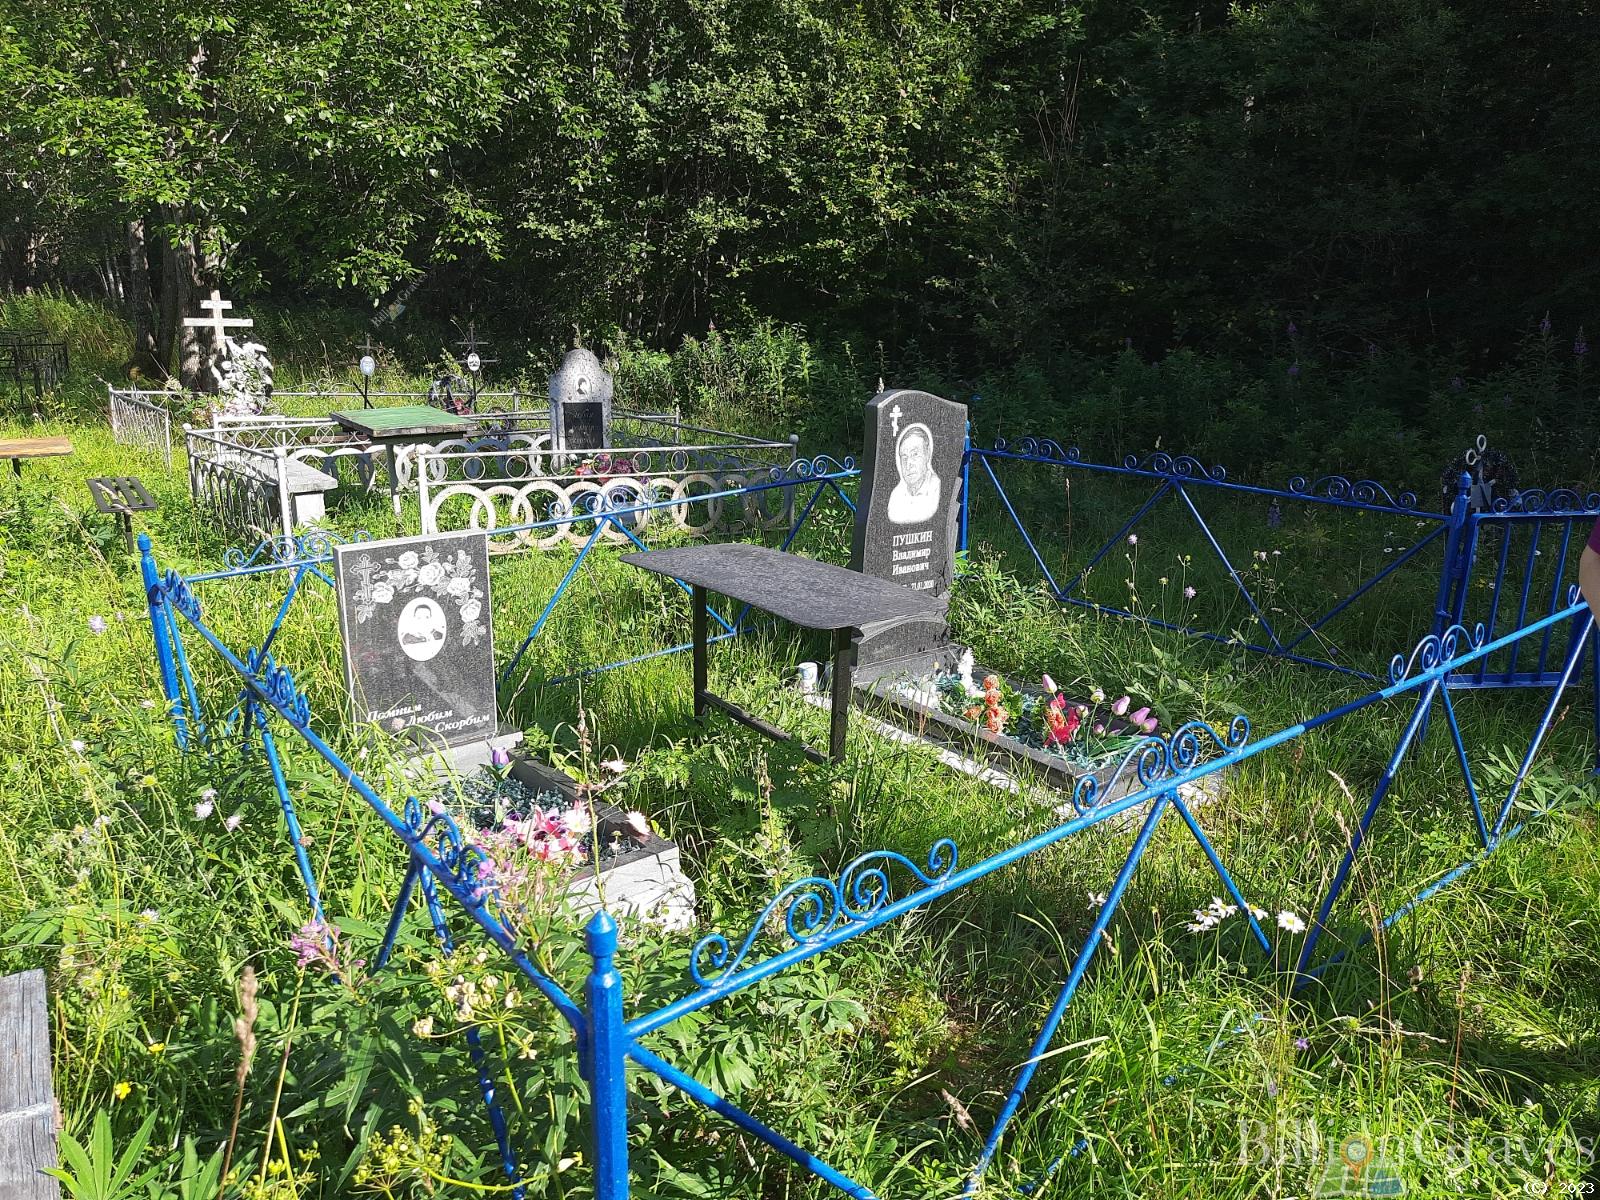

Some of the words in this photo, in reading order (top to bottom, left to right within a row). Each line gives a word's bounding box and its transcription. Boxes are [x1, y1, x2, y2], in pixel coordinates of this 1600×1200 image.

[893, 531, 933, 546] ПУШКИН
[892, 548, 931, 561] Владимир
[892, 562, 929, 575] Иванович
[366, 703, 422, 722] Помним
[405, 709, 453, 726] Любим
[434, 714, 490, 732] Скорбим
